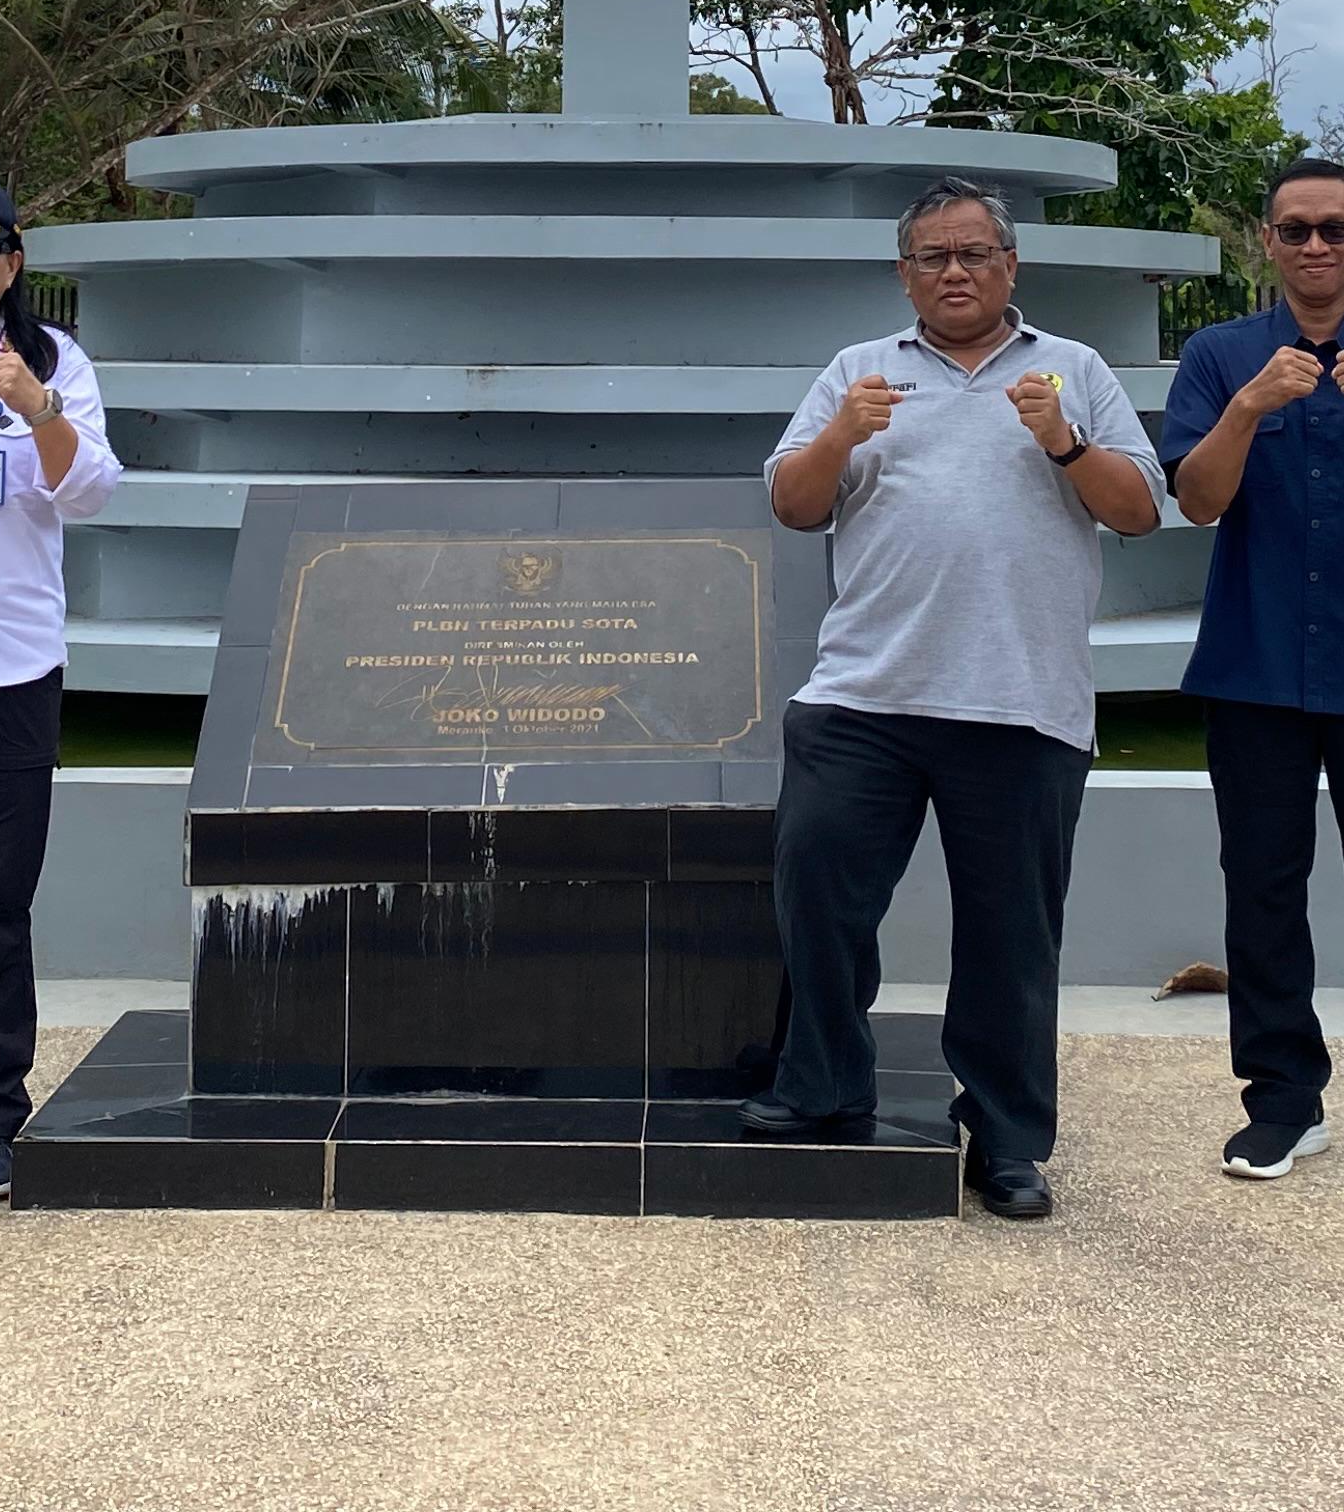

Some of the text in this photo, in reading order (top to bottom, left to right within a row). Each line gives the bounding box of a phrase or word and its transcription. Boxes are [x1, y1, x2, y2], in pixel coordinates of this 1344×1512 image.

[413, 618, 638, 632] PLBN TERPADU SOTA
[345, 651, 700, 668] PRESIDEN REPUBLIK INDONESIA
[433, 707, 606, 723] JOKO WIDODO
